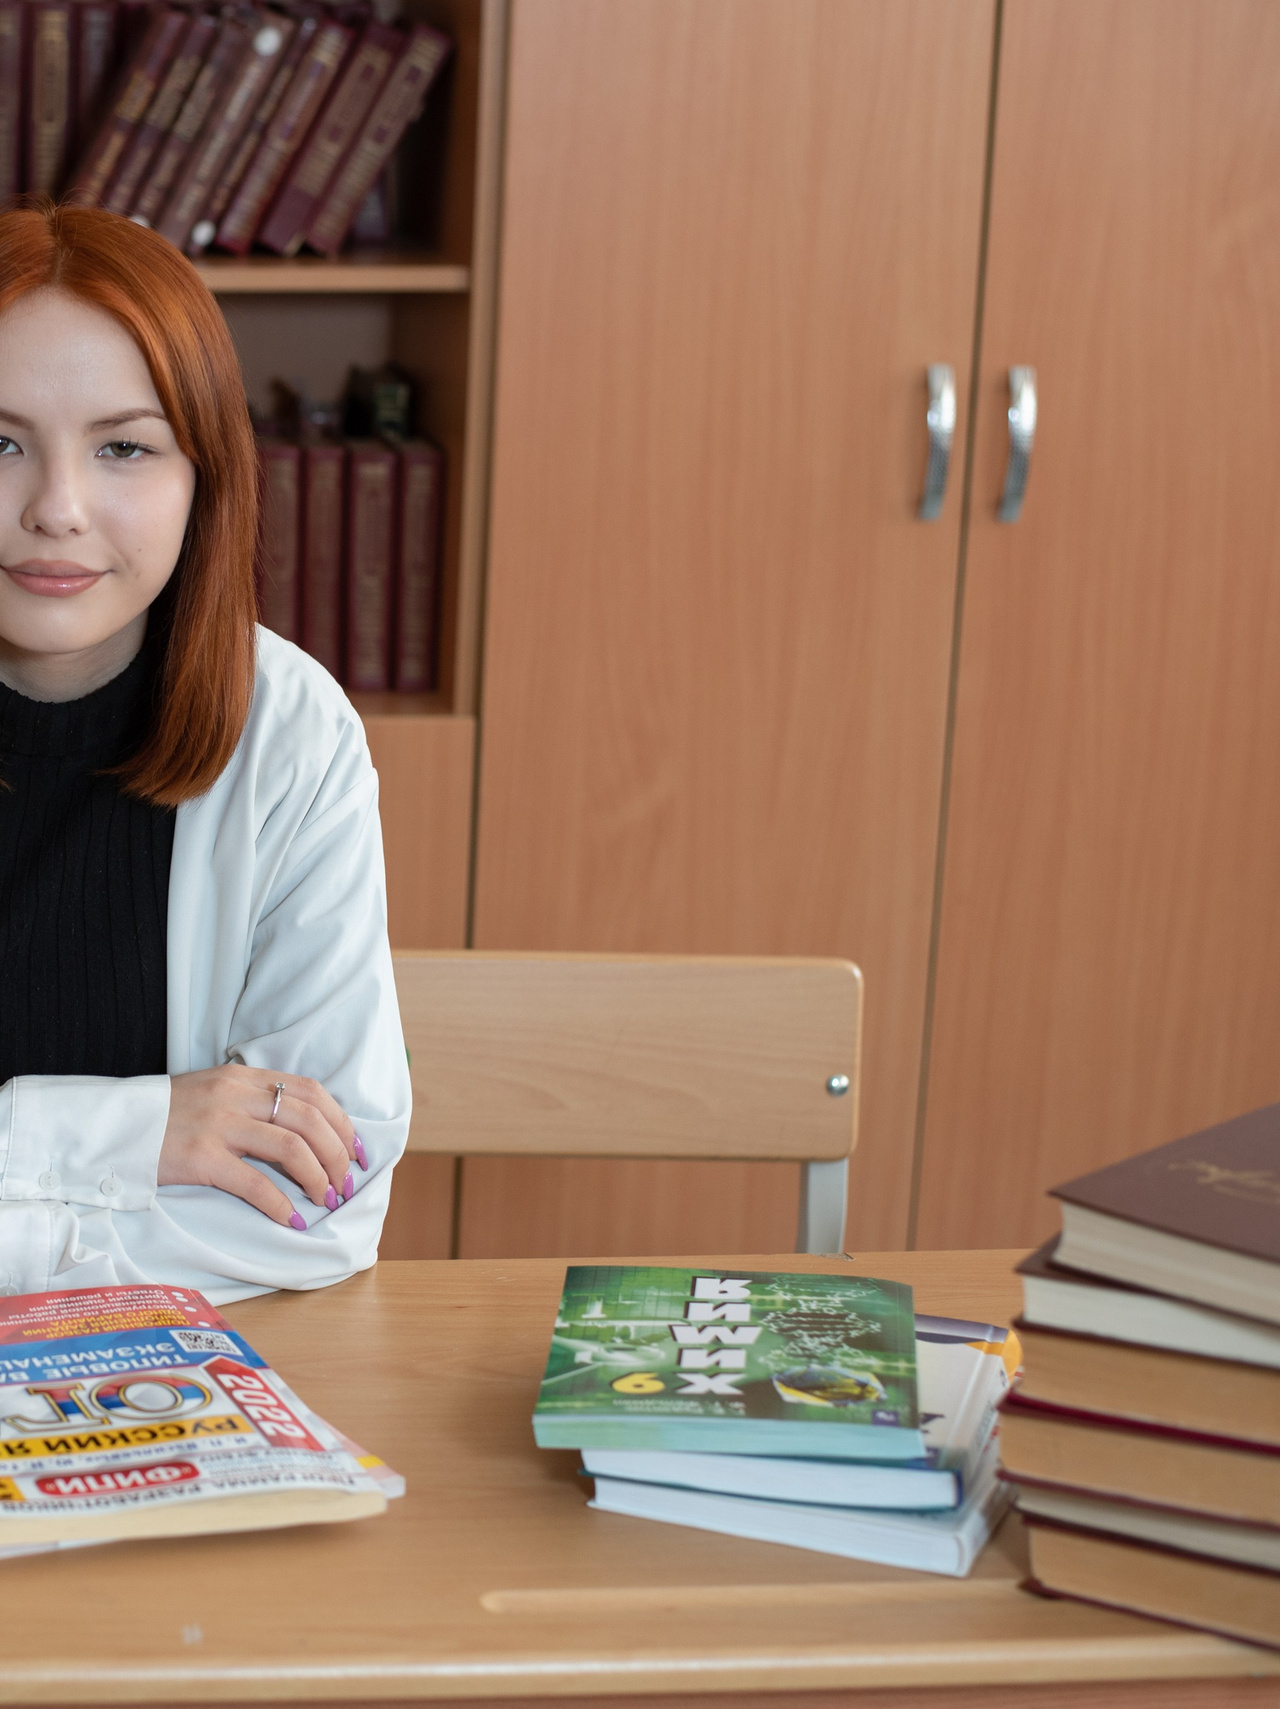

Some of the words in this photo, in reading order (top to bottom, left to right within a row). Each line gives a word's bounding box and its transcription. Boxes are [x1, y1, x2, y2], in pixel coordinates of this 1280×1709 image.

[46, 1292, 102, 1305] решения
[108, 1293, 170, 1304] Критерии
[116, 1289, 165, 1298] Ответы
[28, 1298, 105, 1313] оценивания
[59, 1299, 173, 1315] экзаменационной
[102, 1304, 178, 1315] Инструкция
[8, 1309, 57, 1320] работы
[45, 1327, 100, 1339] РАЗБОР
[670, 1277, 763, 1396] ХИМИЯ
[41, 1353, 190, 1380] ТИПОВЫЕ
[611, 1372, 666, 1396] 9
[228, 1372, 309, 1439] 2022
[42, 1417, 239, 1456] РУССКИЙ
